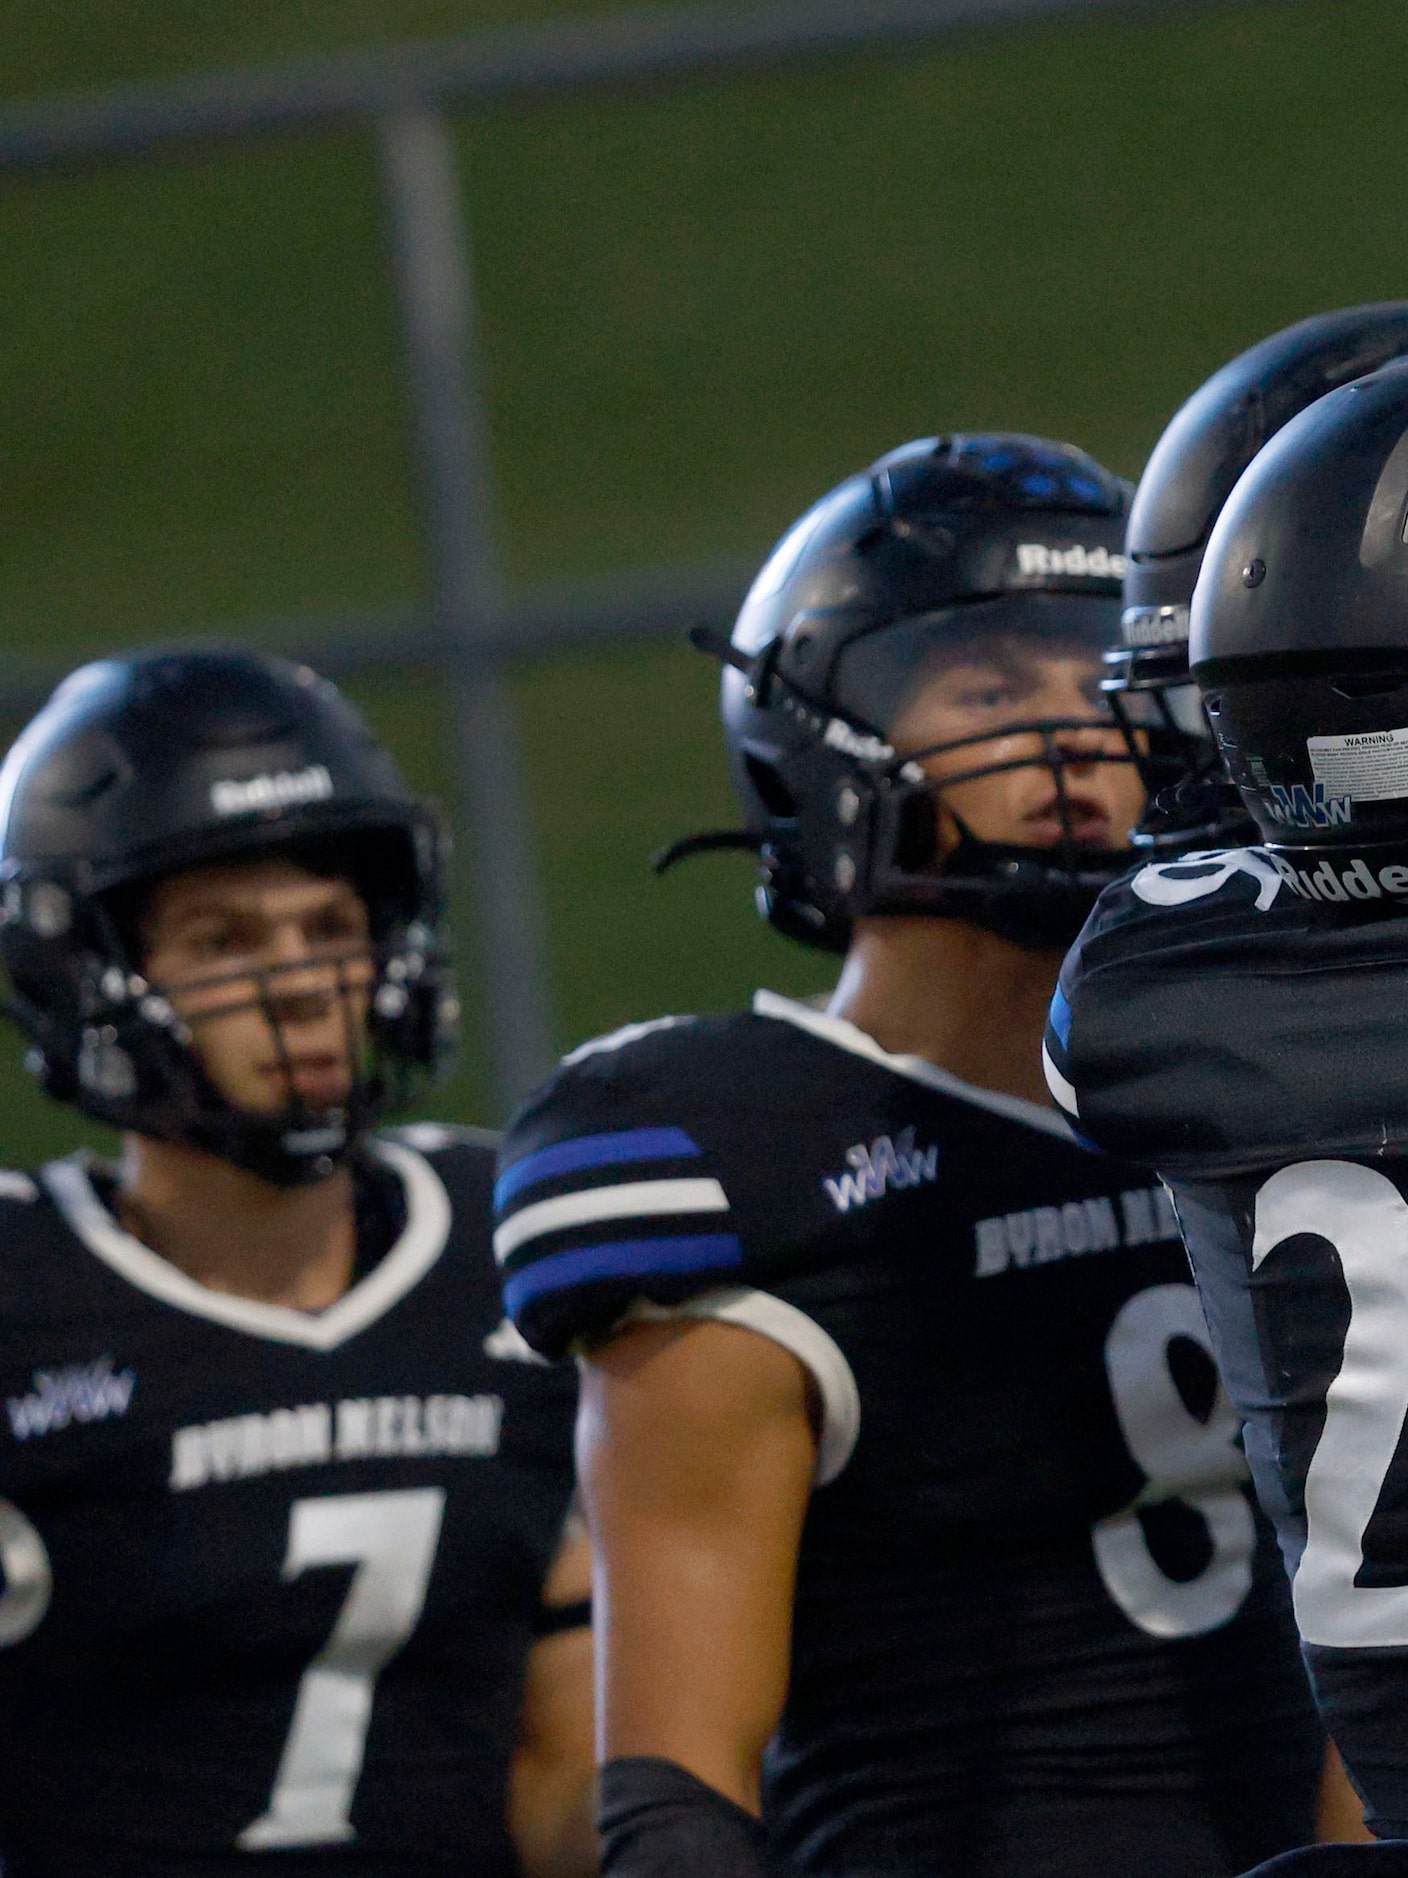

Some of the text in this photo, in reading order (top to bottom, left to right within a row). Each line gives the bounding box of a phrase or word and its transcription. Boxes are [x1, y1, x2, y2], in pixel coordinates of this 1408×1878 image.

[1344, 734, 1394, 747] WARNING
[974, 1196, 1118, 1278] BYRON
[169, 1393, 503, 1492] BYRON NELSON
[1090, 1282, 1257, 1640] 8
[236, 1486, 446, 1850] 7
